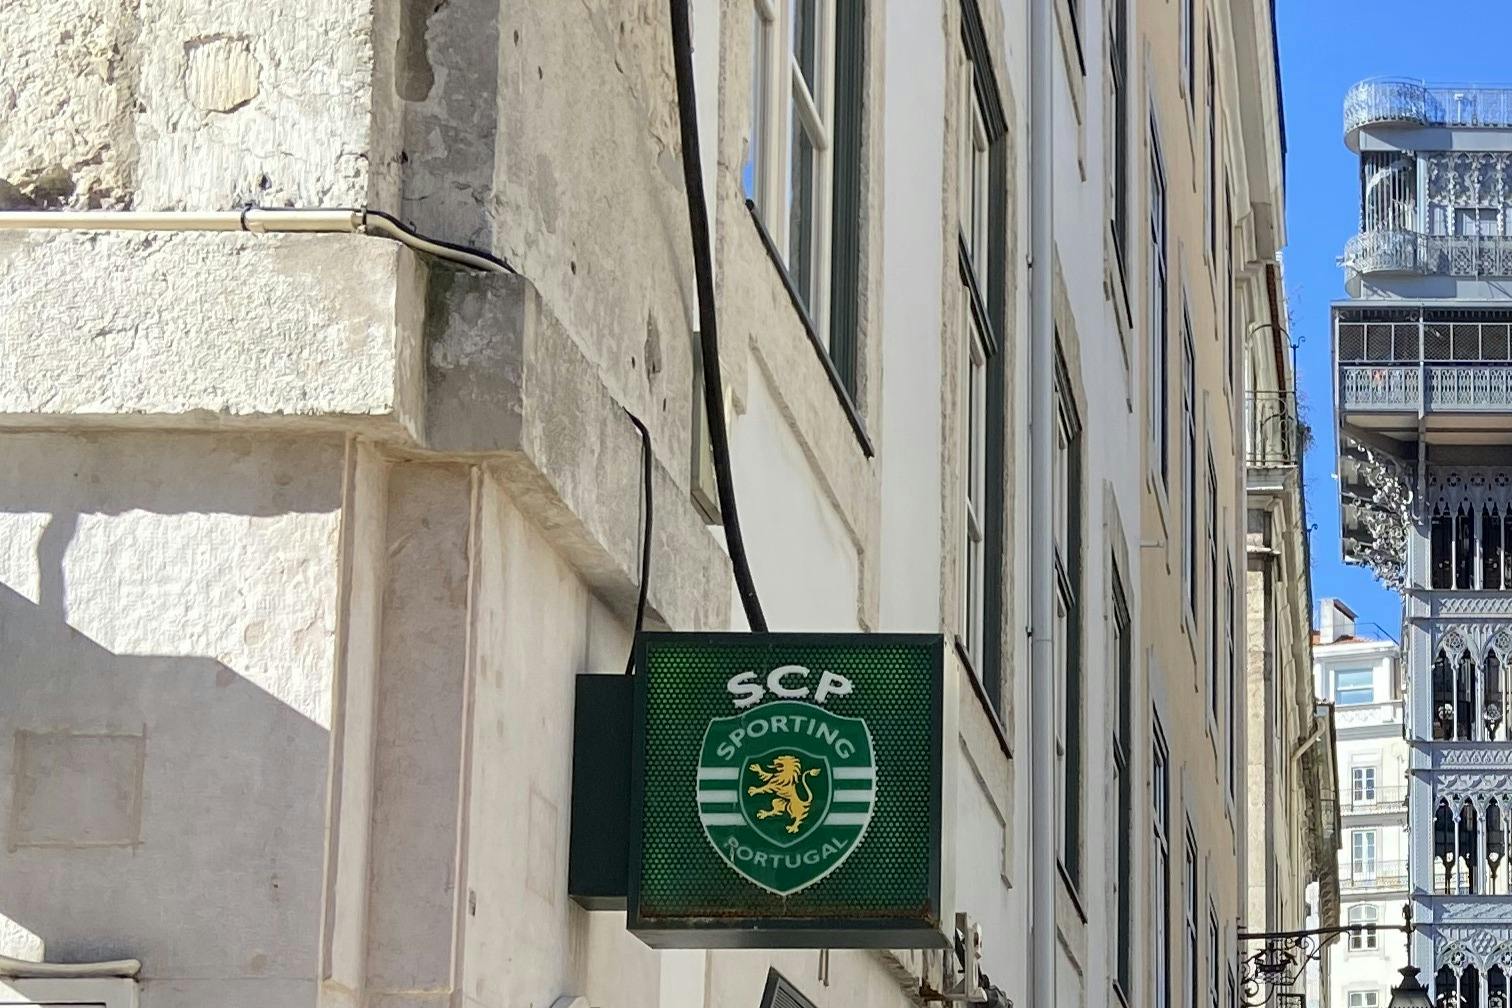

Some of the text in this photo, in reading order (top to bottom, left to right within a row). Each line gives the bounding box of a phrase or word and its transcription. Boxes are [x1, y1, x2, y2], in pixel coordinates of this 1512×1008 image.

[727, 665, 855, 708] SCP
[716, 715, 856, 761] SPORTING
[723, 835, 848, 869] PORTUGAL
